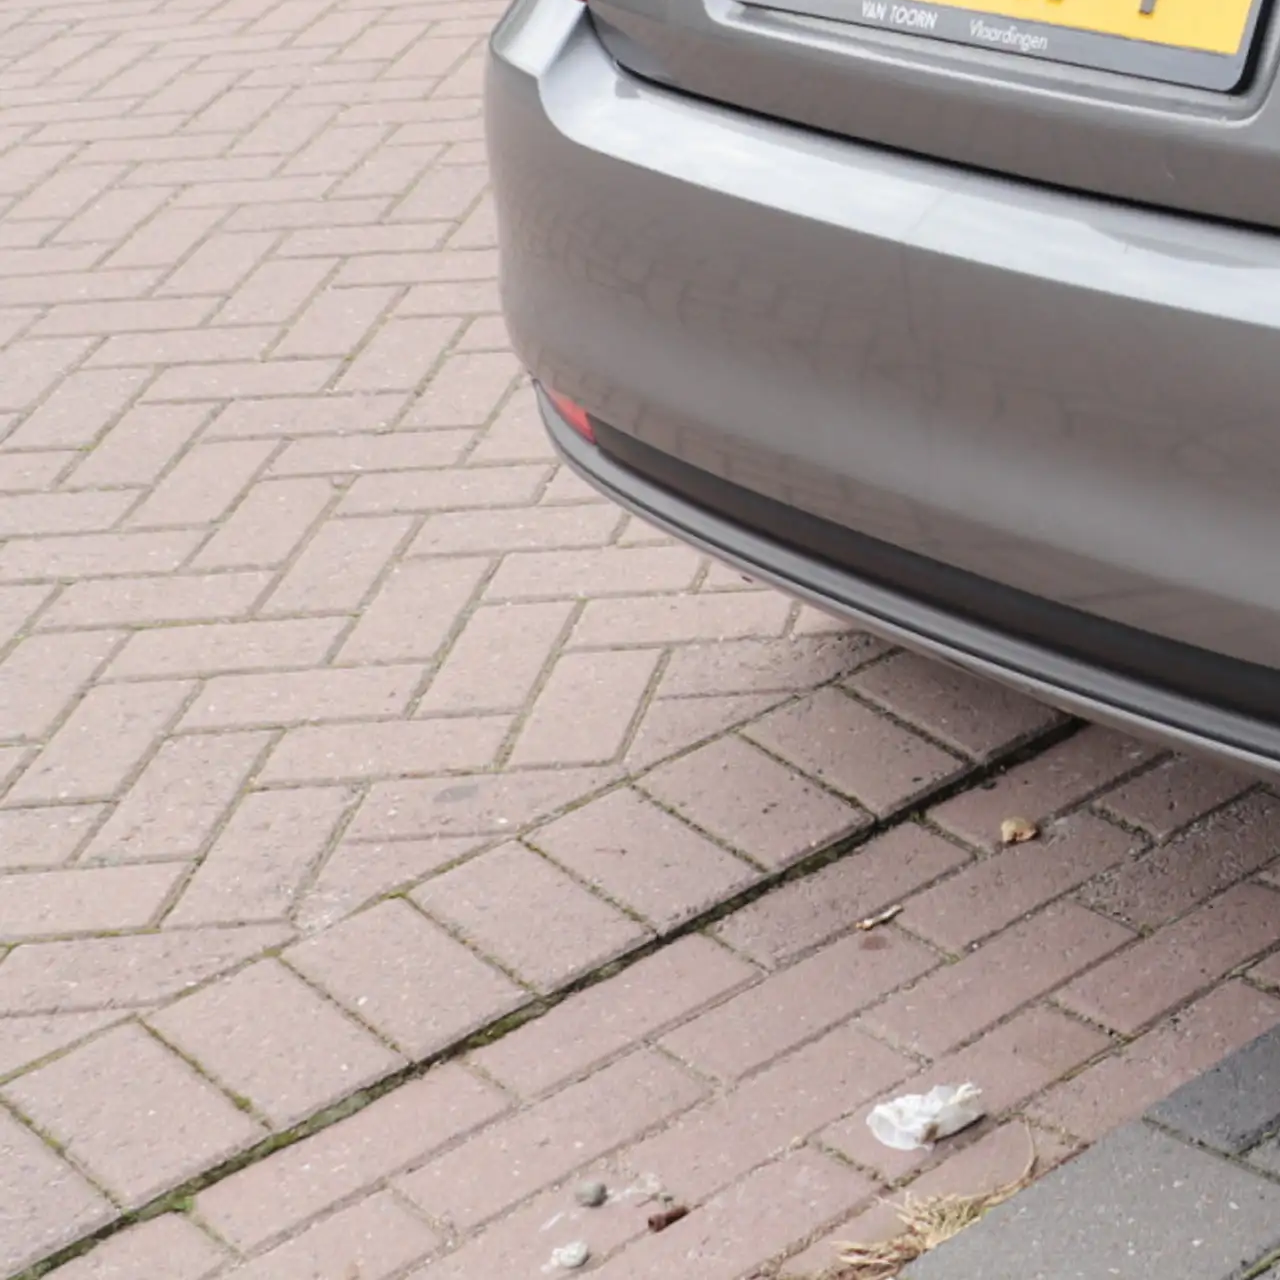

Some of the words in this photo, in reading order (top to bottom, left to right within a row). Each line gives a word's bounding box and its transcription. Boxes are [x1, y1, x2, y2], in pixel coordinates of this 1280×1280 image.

[861, 0, 888, 20] VAN
[890, 5, 938, 30] TOORN
[970, 19, 1048, 52] Vlaardingen
